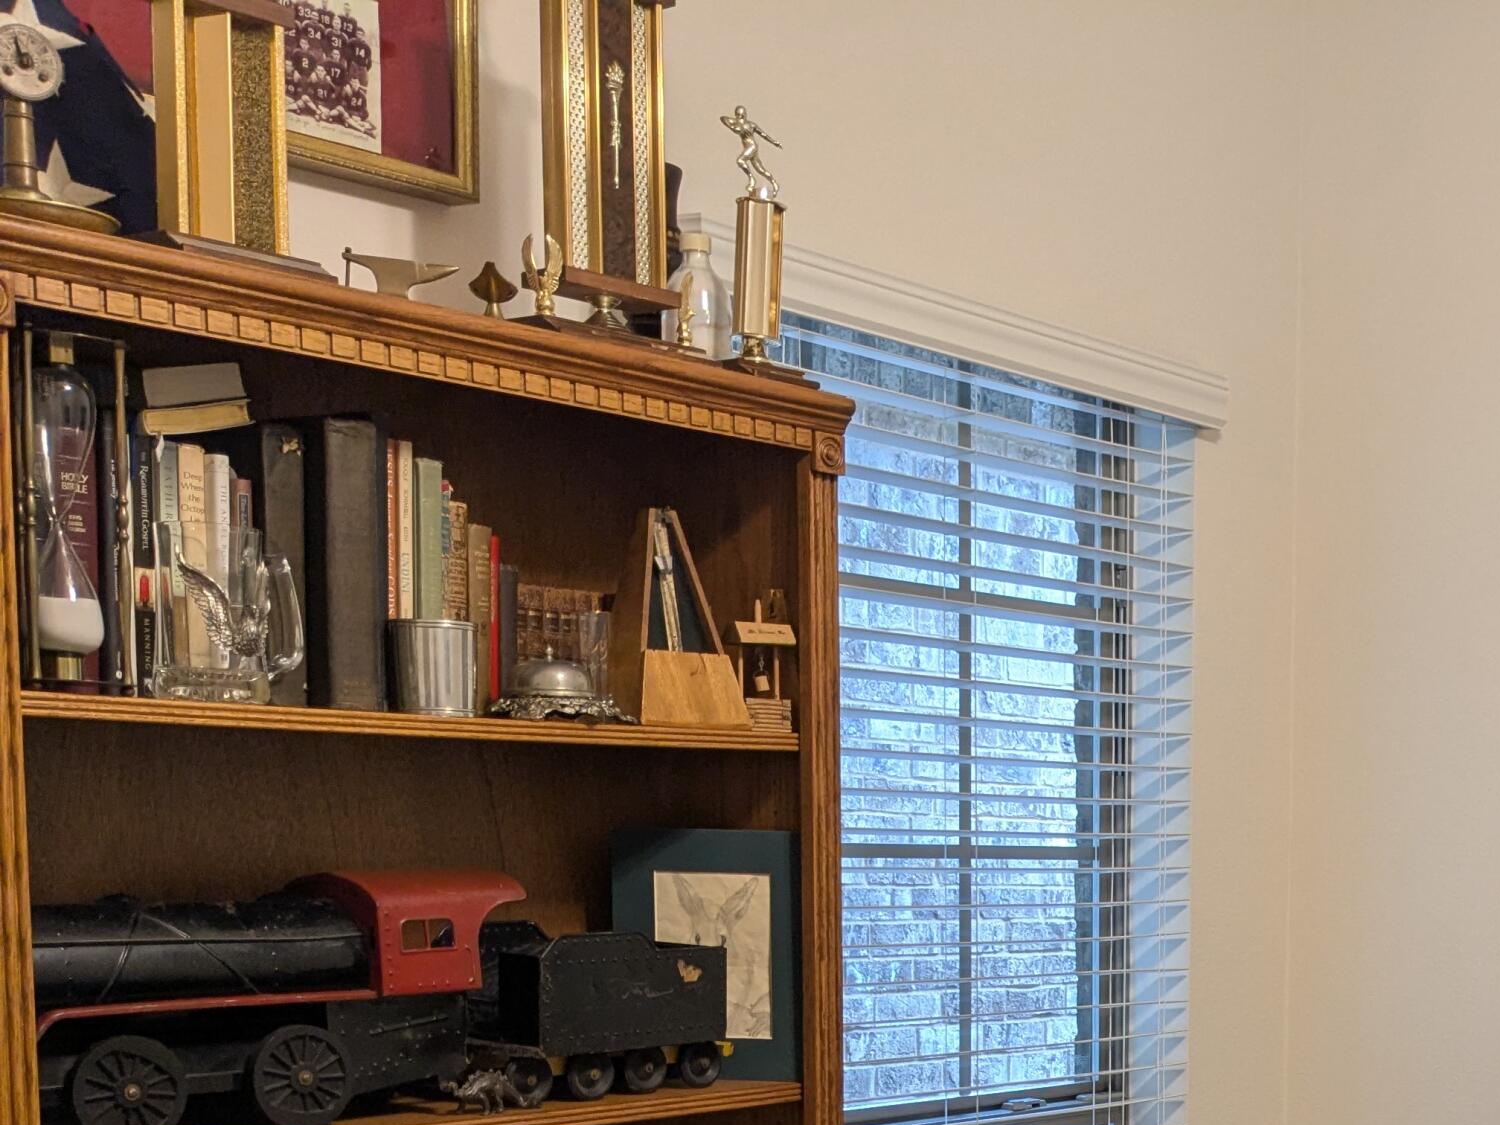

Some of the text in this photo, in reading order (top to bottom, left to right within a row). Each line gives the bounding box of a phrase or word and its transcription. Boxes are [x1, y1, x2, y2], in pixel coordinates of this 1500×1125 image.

[60, 471, 89, 485] HOLY
[220, 484, 228, 504] THE
[143, 617, 152, 670] MANNING
